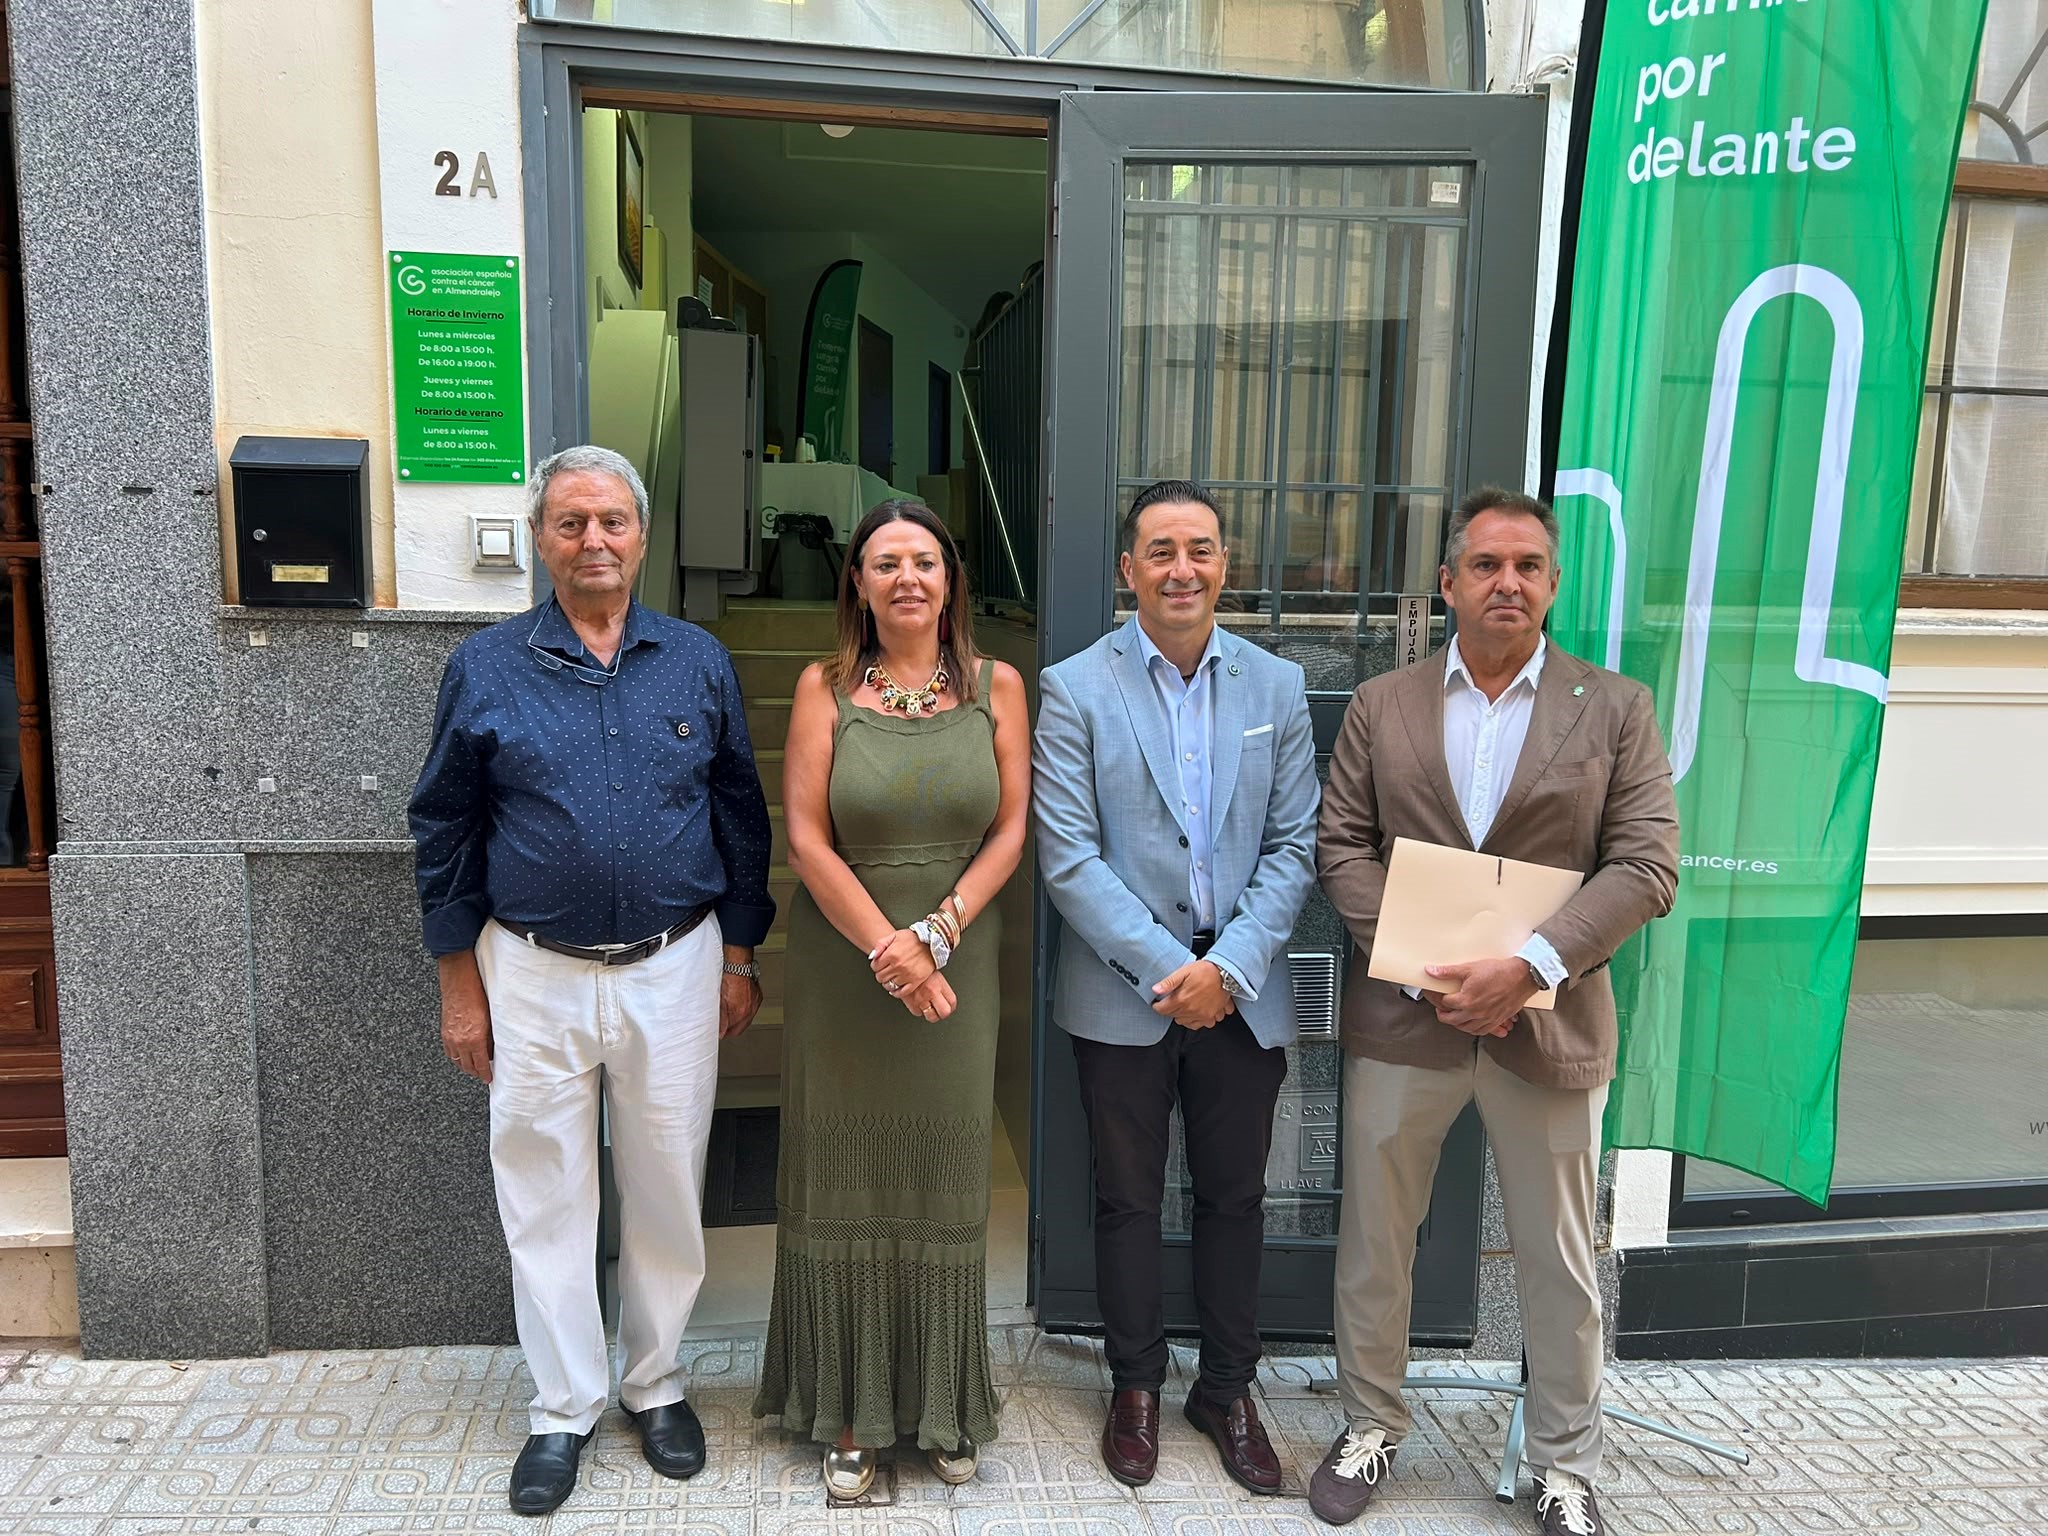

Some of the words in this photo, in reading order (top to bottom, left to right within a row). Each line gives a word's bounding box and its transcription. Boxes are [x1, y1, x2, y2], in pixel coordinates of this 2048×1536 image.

[1633, 51, 1727, 123] por
[1626, 116, 1857, 185] delante
[431, 268, 474, 277] asociación
[475, 270, 513, 279] española
[431, 278, 458, 286] contra
[458, 278, 467, 286] el
[467, 279, 495, 287] cáncer
[445, 287, 501, 298] Almendralejo
[407, 307, 446, 318] Horario
[447, 309, 461, 318] de
[463, 310, 505, 320] Invierno
[418, 330, 444, 338] Lunes
[453, 331, 496, 340] miércoles
[419, 344, 432, 352] De
[433, 344, 454, 353] 8:00
[461, 345, 485, 354] 15:00
[486, 346, 495, 354] h.
[418, 358, 431, 366] De
[432, 358, 456, 367] 16:00
[464, 360, 488, 368] 19:00
[488, 360, 497, 369] h.
[423, 376, 454, 385] Jueves
[454, 378, 461, 386] y
[461, 377, 494, 386] viernes
[421, 390, 434, 398] De
[434, 390, 455, 399] 8:00
[463, 391, 487, 399] 15:00
[488, 392, 497, 400] h.
[414, 407, 453, 416] Horario
[454, 408, 468, 417] de
[469, 410, 504, 418] verano
[423, 426, 449, 435] Lunes
[457, 427, 489, 436] viernes
[423, 440, 435, 448] de
[436, 441, 456, 449] 8:00
[465, 441, 488, 450] 15:00
[489, 442, 498, 450] h.
[1407, 600, 1418, 665] EMPUJAR
[2029, 1121, 2048, 1135] w
[1281, 1177, 1322, 1190] LLAVE
